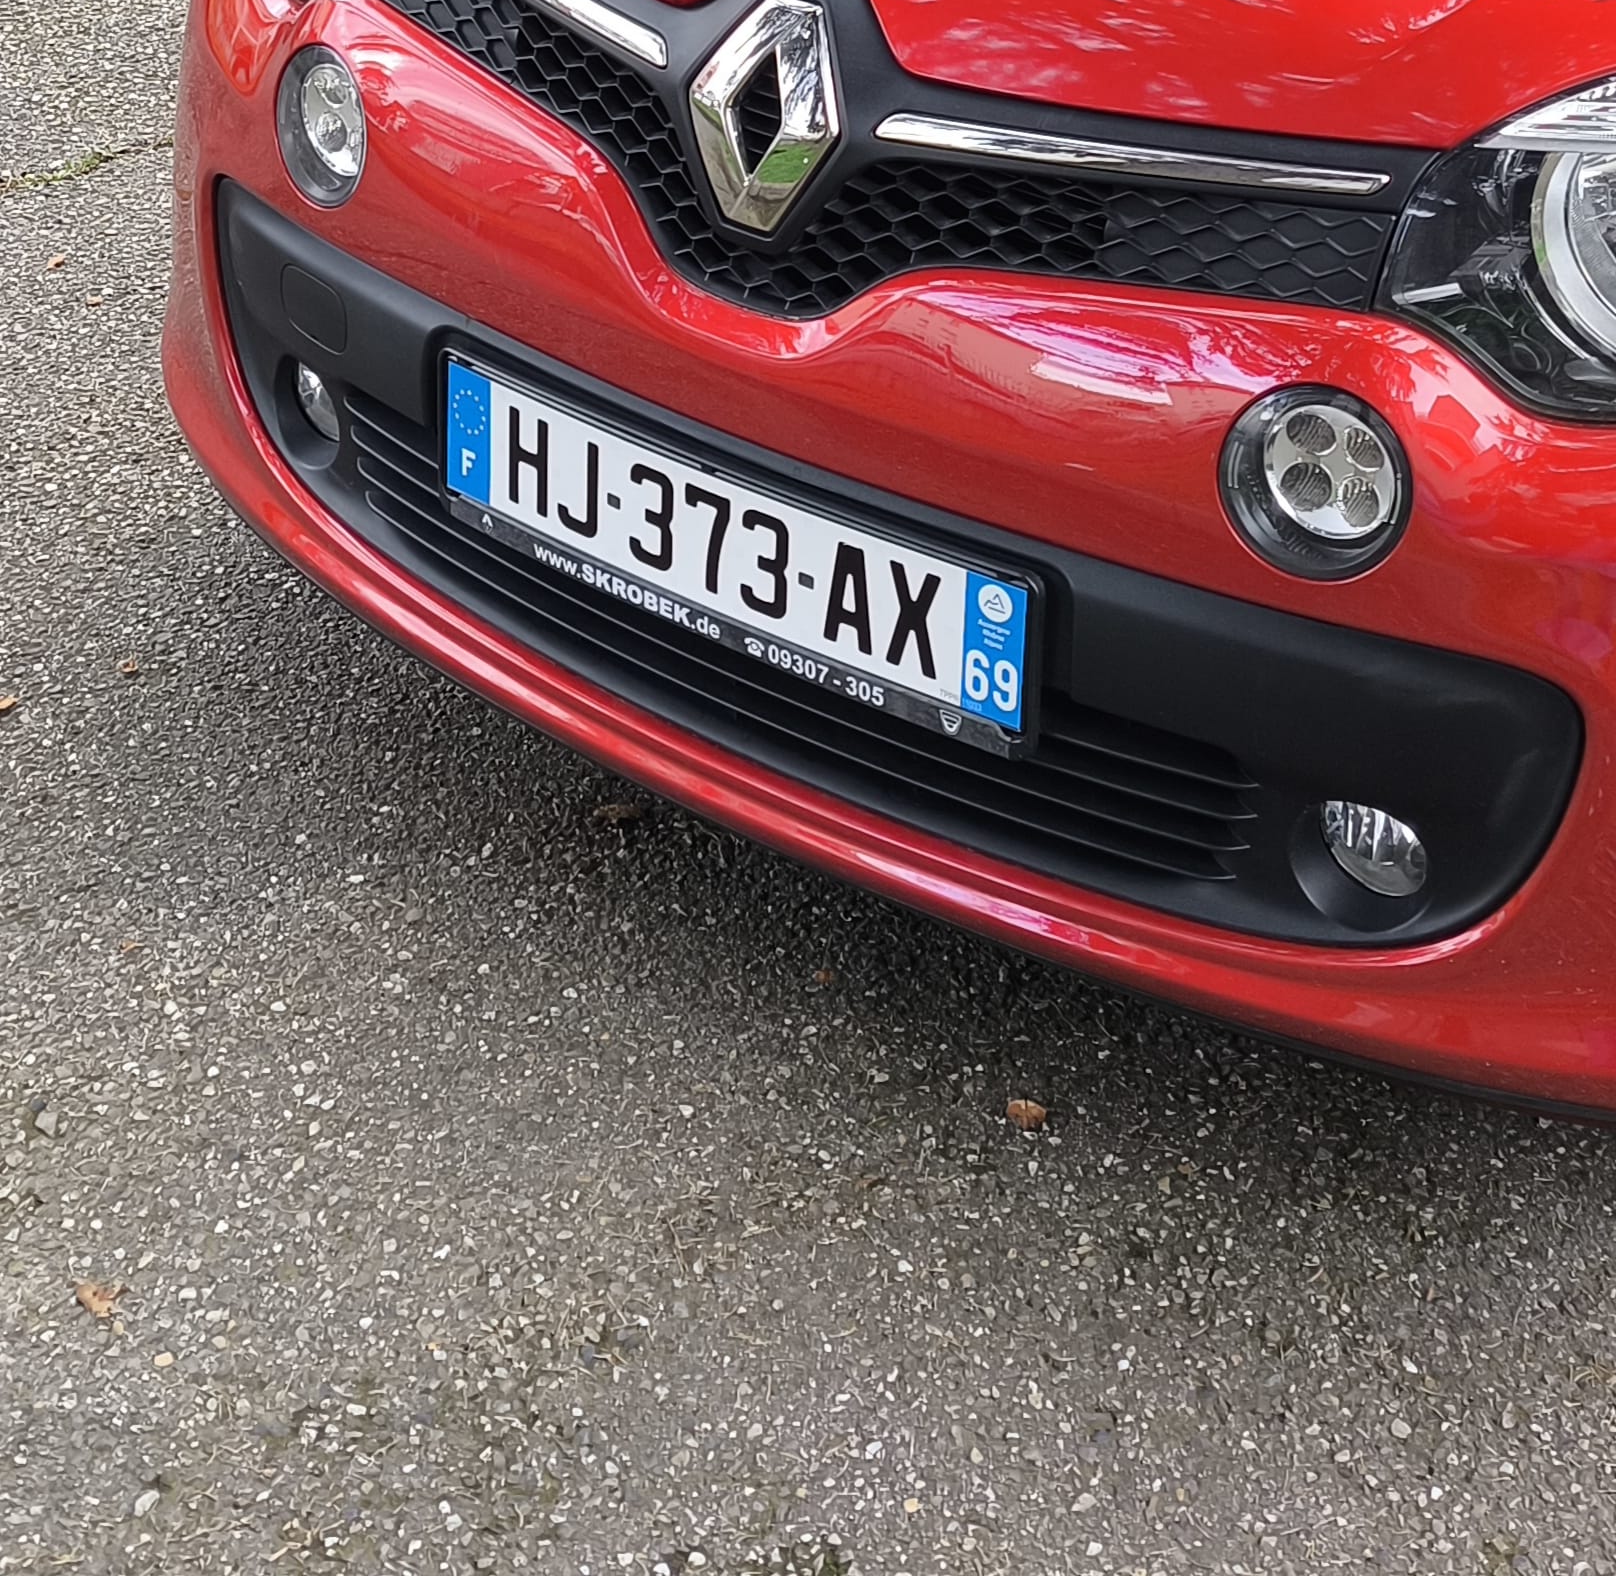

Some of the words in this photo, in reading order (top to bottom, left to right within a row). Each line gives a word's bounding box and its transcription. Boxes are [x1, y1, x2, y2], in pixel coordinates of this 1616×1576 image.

[460, 447, 477, 478] F
[507, 404, 942, 681] HJ-373-AX
[533, 543, 721, 640] www.SKROBEK.de
[767, 644, 830, 684] 09307
[845, 675, 885, 707] 305
[964, 649, 1018, 712] 69
